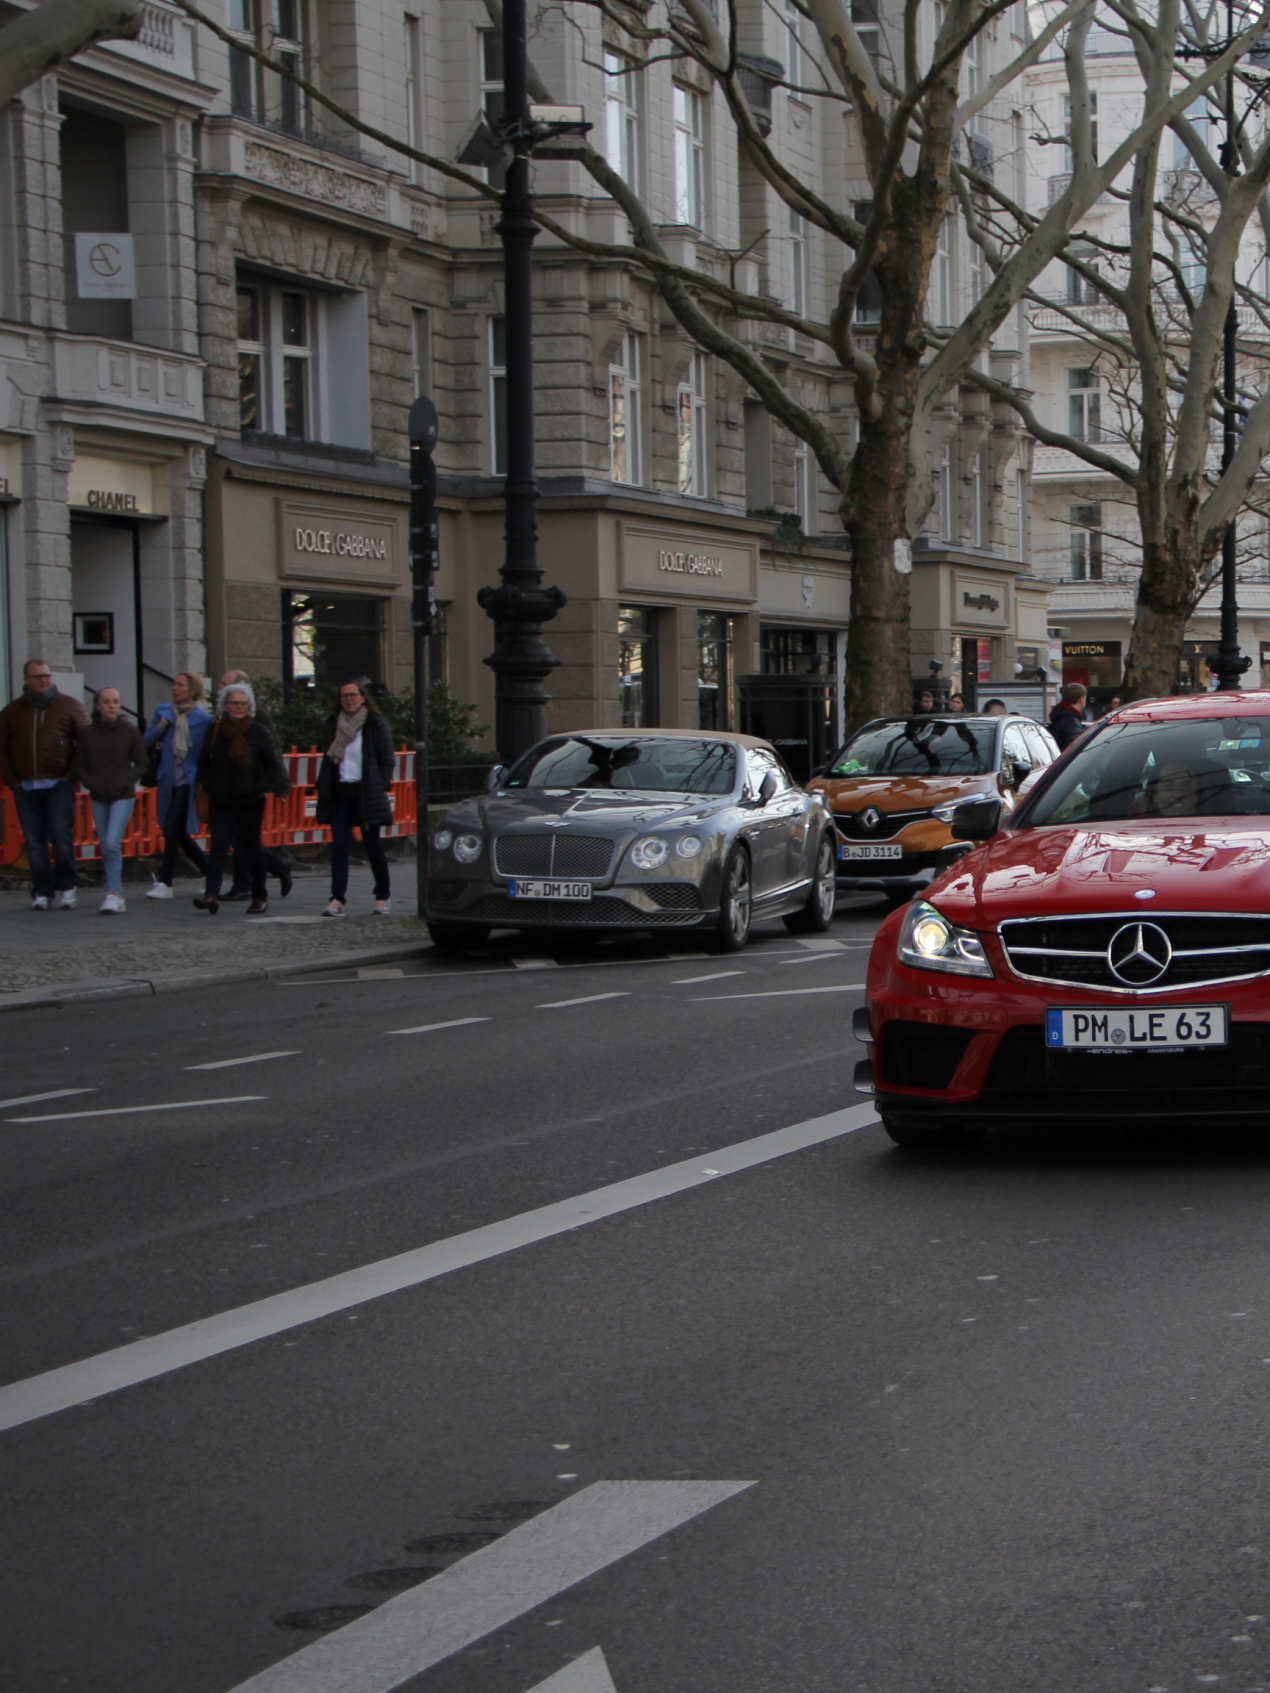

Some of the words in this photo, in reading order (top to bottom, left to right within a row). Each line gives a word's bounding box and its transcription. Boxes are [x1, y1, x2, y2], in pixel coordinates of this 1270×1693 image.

[87, 489, 139, 512] CHANEL
[1064, 645, 1105, 654] VUITTON
[843, 847, 850, 858] B
[857, 847, 871, 858] JD
[873, 846, 900, 858] 3114
[516, 882, 534, 896] NF
[543, 883, 560, 897] DM
[563, 884, 590, 898] 100
[1073, 1014, 1109, 1042] PM
[1129, 1013, 1167, 1042] LE
[1176, 1012, 1211, 1040] 63
